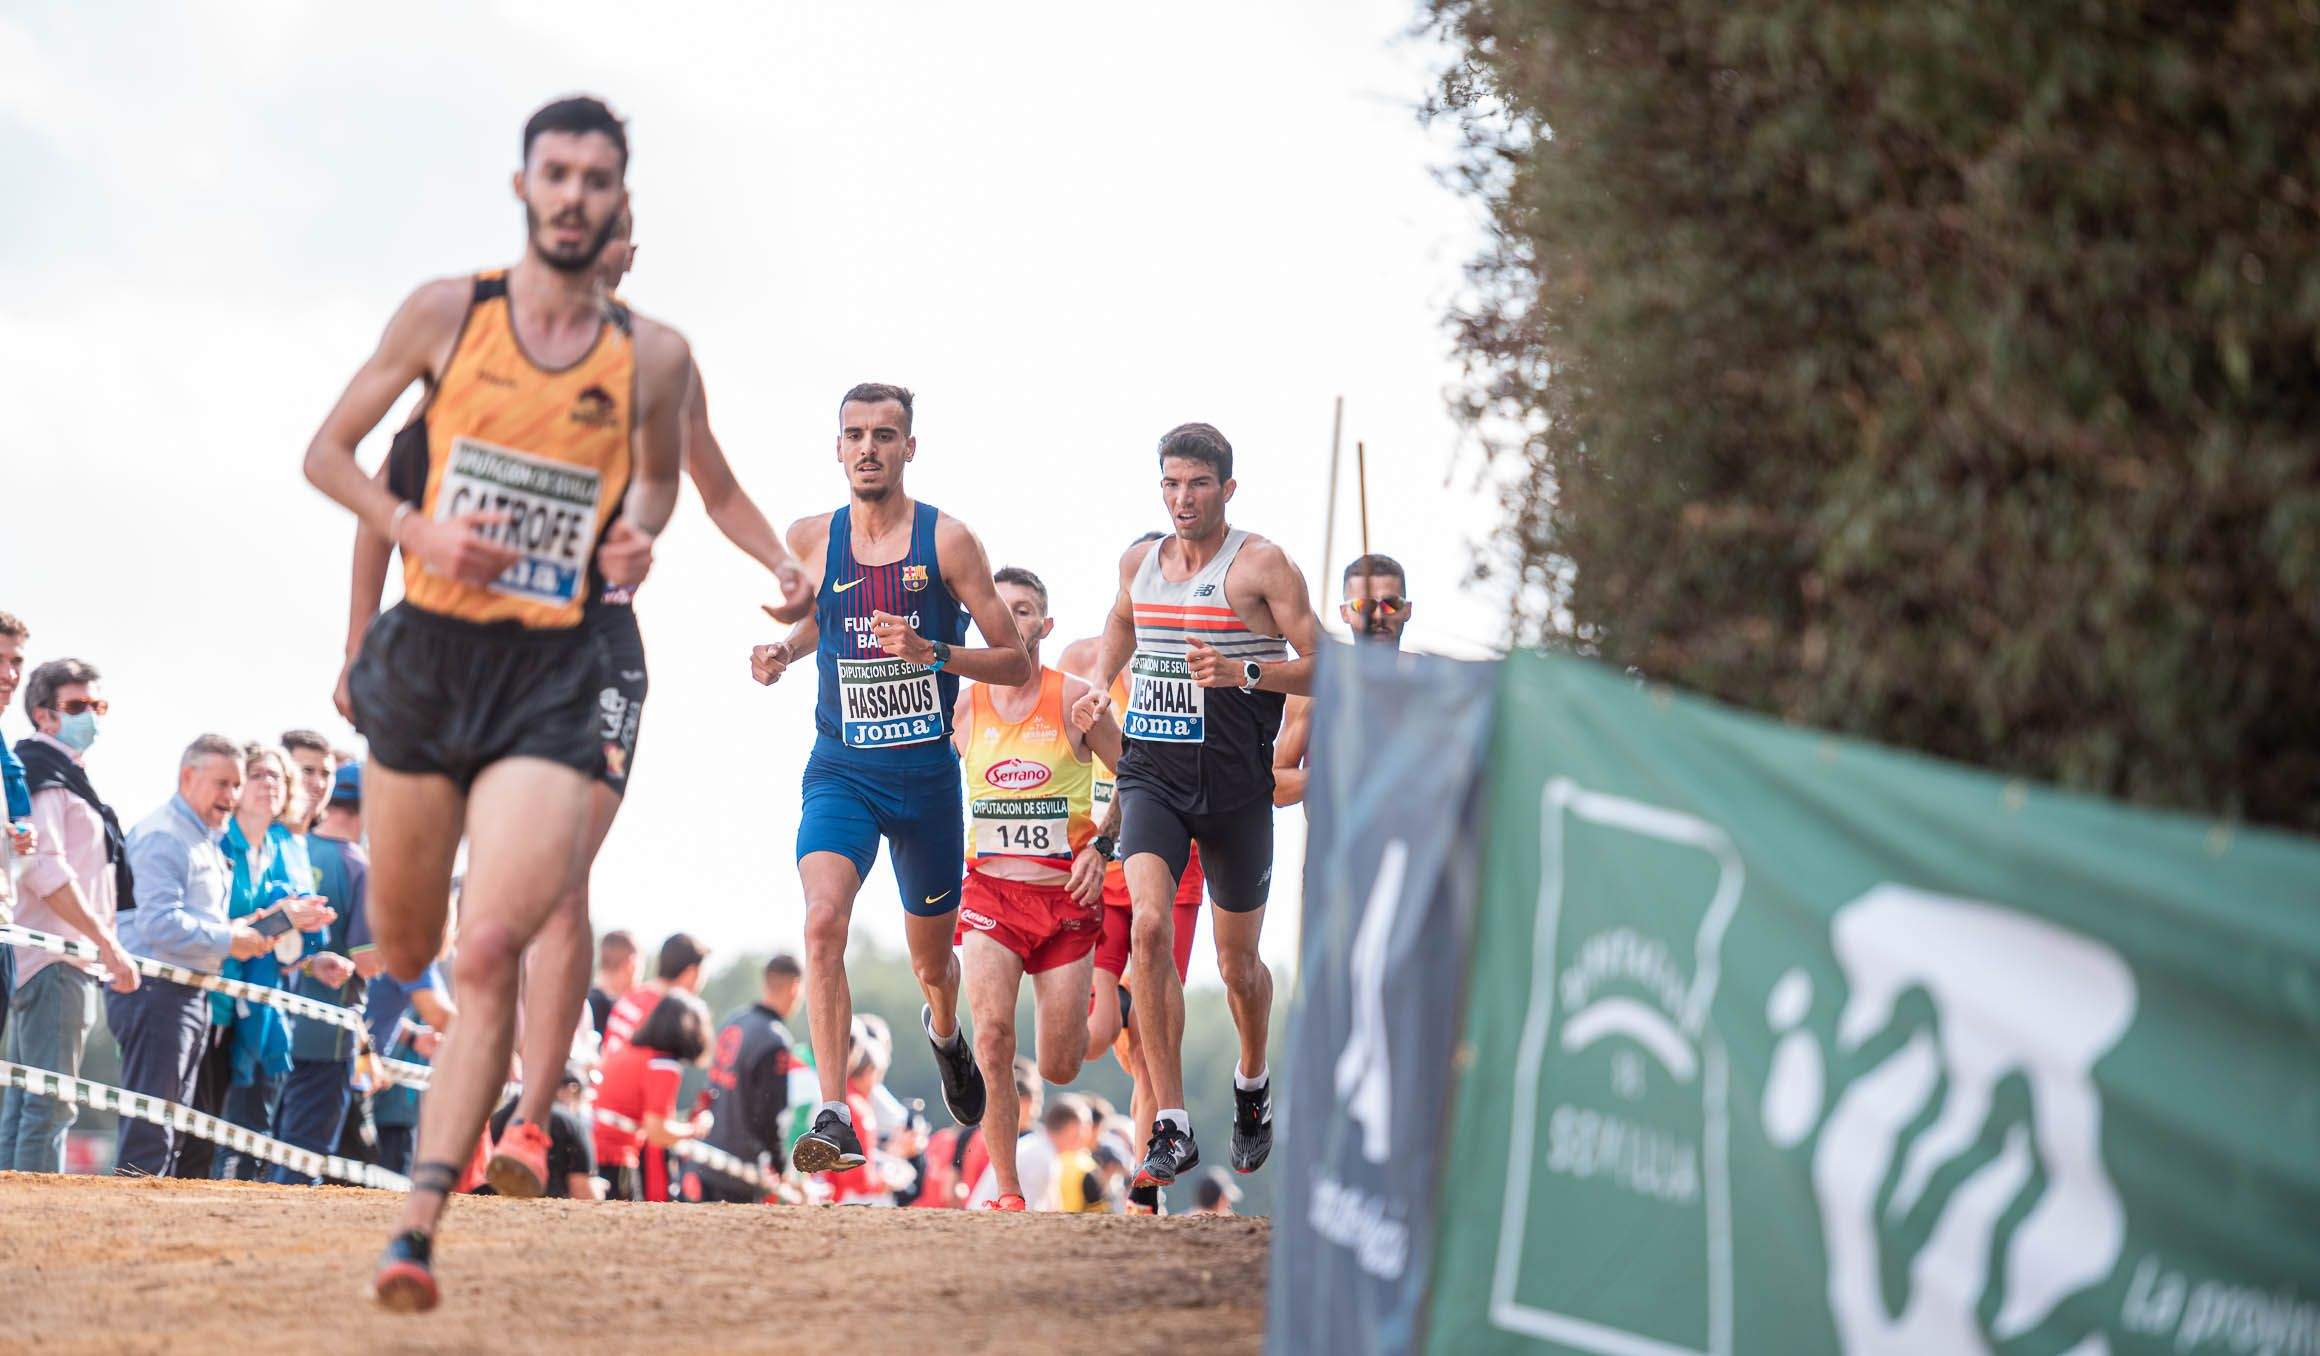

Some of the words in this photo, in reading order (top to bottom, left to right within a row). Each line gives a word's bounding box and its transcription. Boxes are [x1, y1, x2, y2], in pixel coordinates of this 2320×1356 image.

[840, 663, 886, 679] DIPUTACION
[888, 663, 900, 676] DE
[1160, 660, 1170, 672] DE
[847, 679, 934, 719] HASSAOUS
[1132, 677, 1198, 713] MECHAAL
[854, 718, 931, 744] Joma
[1129, 714, 1191, 736] Joma
[992, 769, 1046, 783] Serrano
[973, 801, 1021, 815] DIPUTACION
[1023, 801, 1035, 815] DE
[1035, 800, 1067, 815] SEVILLA
[997, 825, 1050, 850] 148
[2123, 1252, 2187, 1334] La
